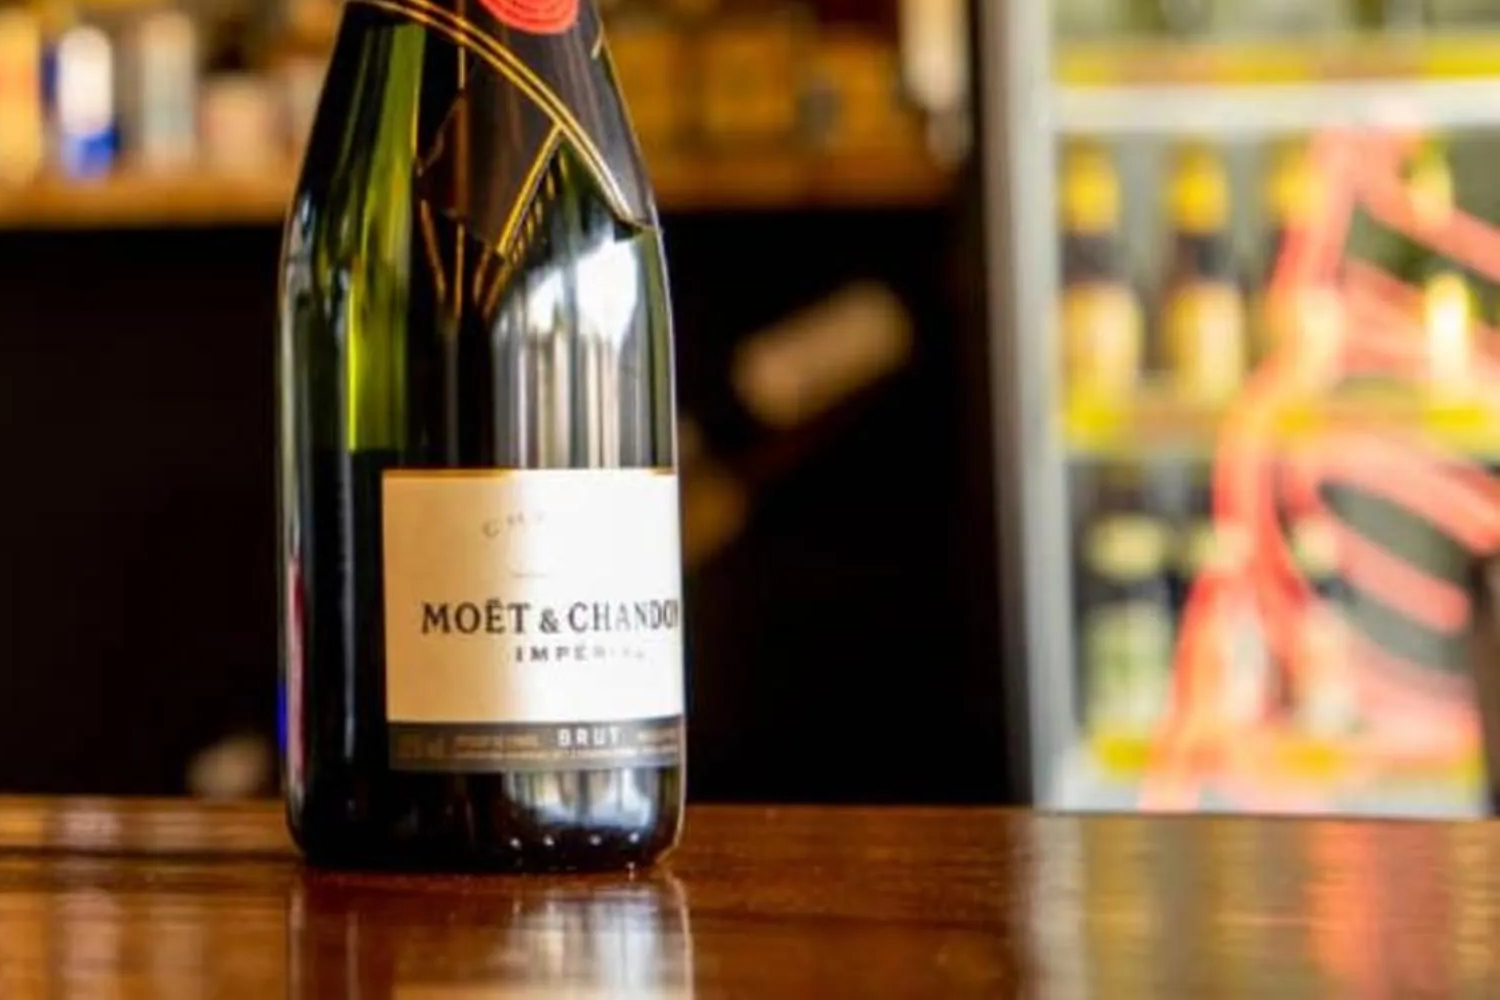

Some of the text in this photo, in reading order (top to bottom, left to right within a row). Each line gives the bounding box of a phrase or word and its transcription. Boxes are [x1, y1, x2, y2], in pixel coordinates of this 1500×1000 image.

[421, 598, 530, 635] MOËT
[538, 610, 561, 634] &
[557, 728, 620, 746] BRUT
